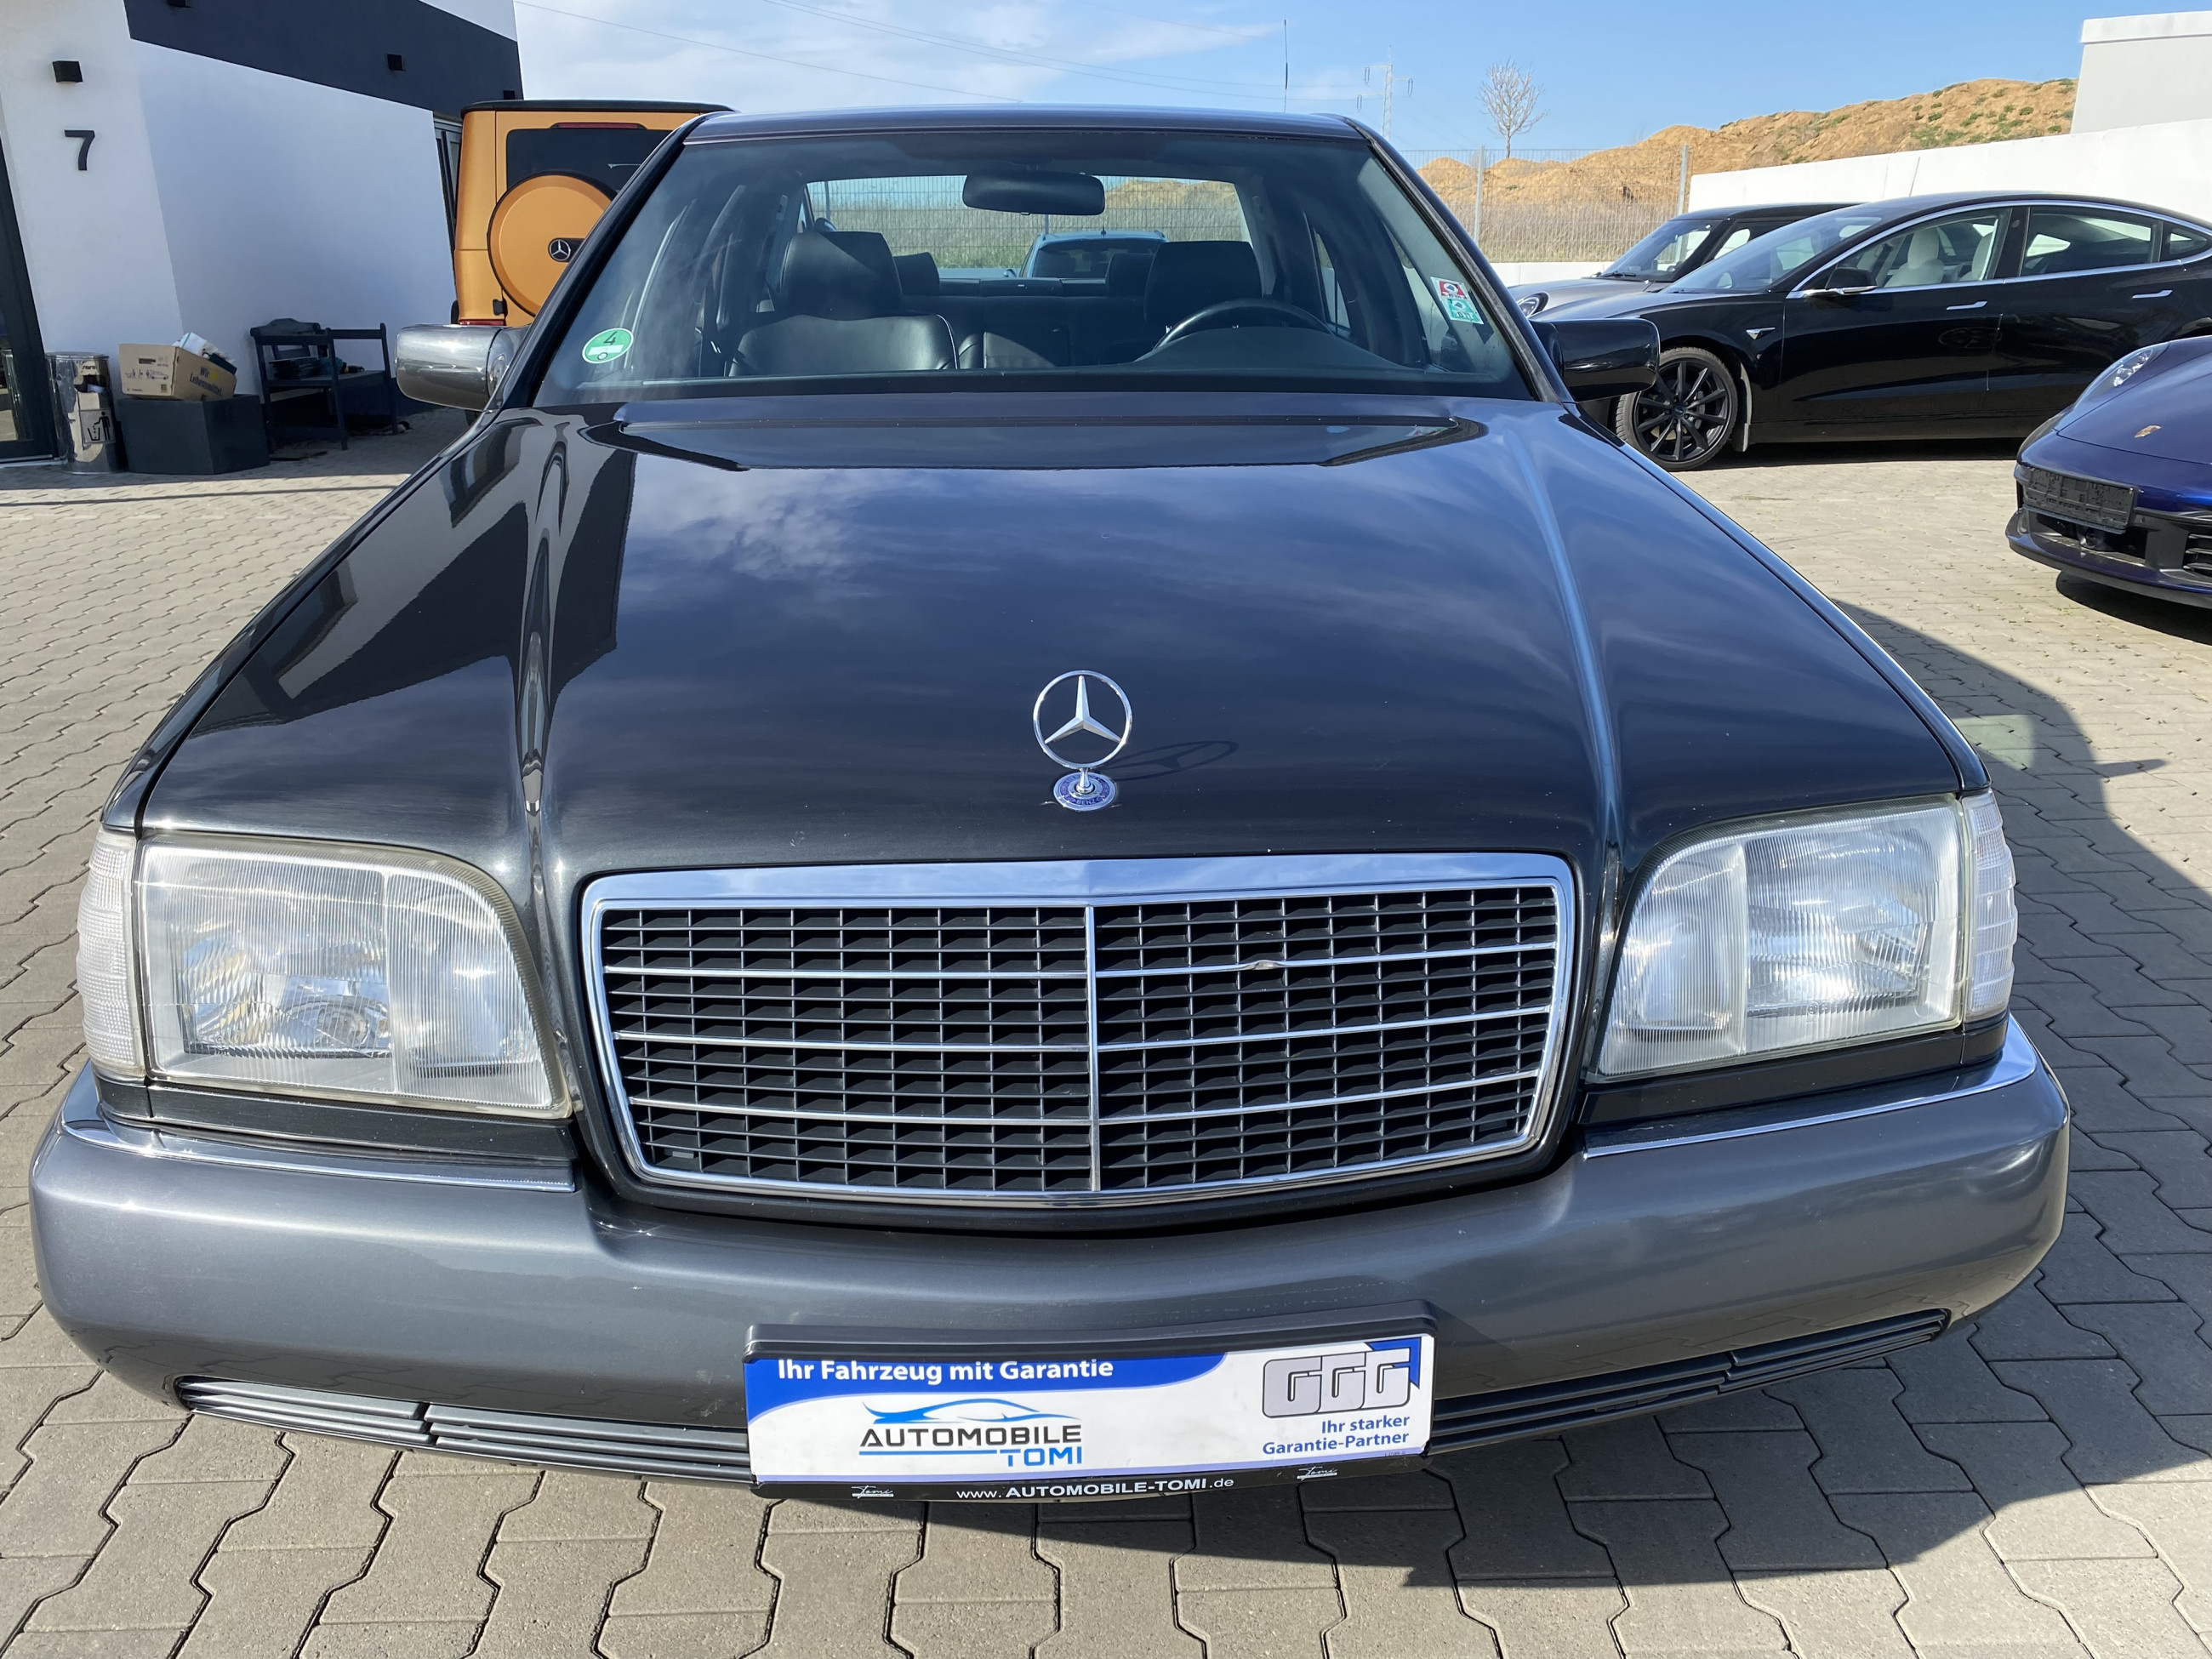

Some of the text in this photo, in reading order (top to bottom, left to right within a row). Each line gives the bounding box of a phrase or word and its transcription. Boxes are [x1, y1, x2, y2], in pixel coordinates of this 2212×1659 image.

[64, 129, 95, 171] 7
[603, 331, 618, 345] 4
[778, 1359, 1114, 1385] Ihr Fahrzeug mit Garantie
[860, 1424, 1082, 1447] AUTOMOBILE
[1321, 1415, 1410, 1434] Ihr starker
[1263, 1433, 1410, 1455] Garantie-Partner
[999, 1446, 1082, 1467] TOMI
